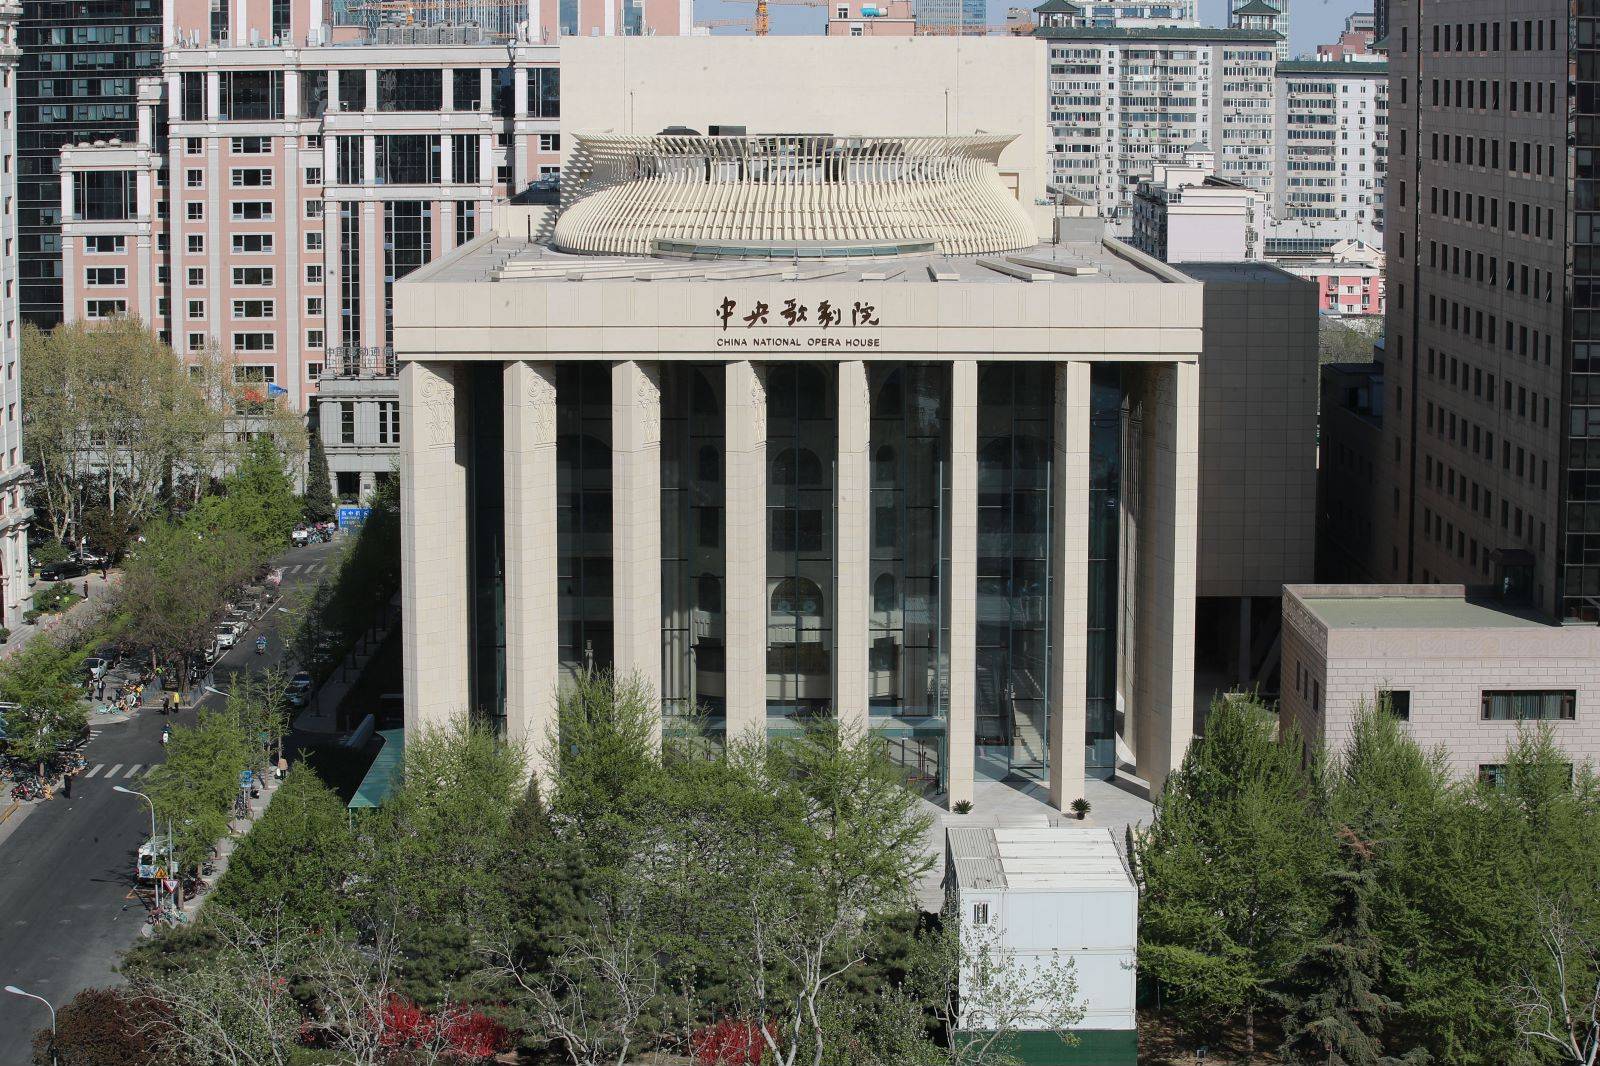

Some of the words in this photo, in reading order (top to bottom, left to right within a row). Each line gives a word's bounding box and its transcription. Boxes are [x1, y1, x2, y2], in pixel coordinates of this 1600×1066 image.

[716, 338, 748, 347] CHINA
[753, 338, 802, 347] NATIONAL
[807, 338, 842, 347] OPERA
[845, 338, 880, 347] HOUSE
